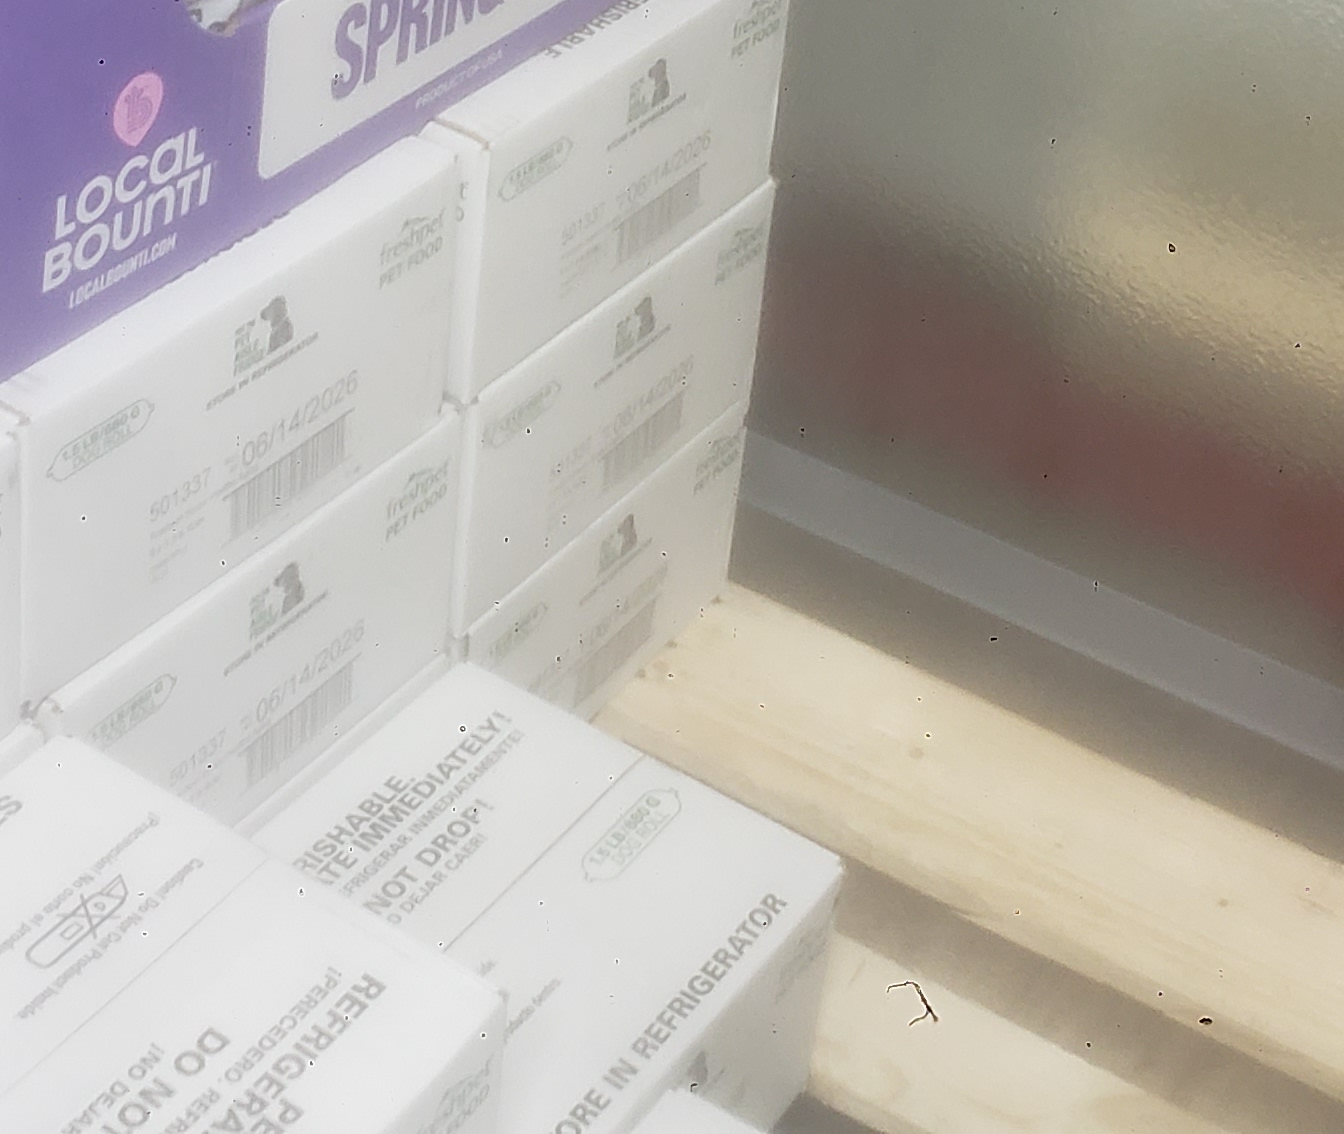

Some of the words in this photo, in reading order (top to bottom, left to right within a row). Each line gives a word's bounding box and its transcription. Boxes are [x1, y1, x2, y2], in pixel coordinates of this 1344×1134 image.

[55, 127, 205, 240] LOCAL
[42, 163, 212, 293] BOUNTI
[379, 262, 403, 291] PET
[407, 236, 443, 271] FOOD
[68, 232, 177, 309] LOCALBOUNTI.COM
[242, 369, 359, 466] 06/14/2026
[149, 467, 211, 522] 501337
[385, 512, 409, 543] PET
[412, 482, 447, 521] FOOD
[352, 709, 513, 853] IMMEDIATELY!
[361, 864, 419, 917] NOT
[414, 796, 496, 868] DROP!
[605, 806, 651, 850] LB/680
[645, 795, 662, 809] G
[399, 868, 449, 915] DEJAR
[602, 1056, 638, 1092] IN
[632, 892, 788, 1060] REFRIGERATOR
[173, 1026, 232, 1078] DO
